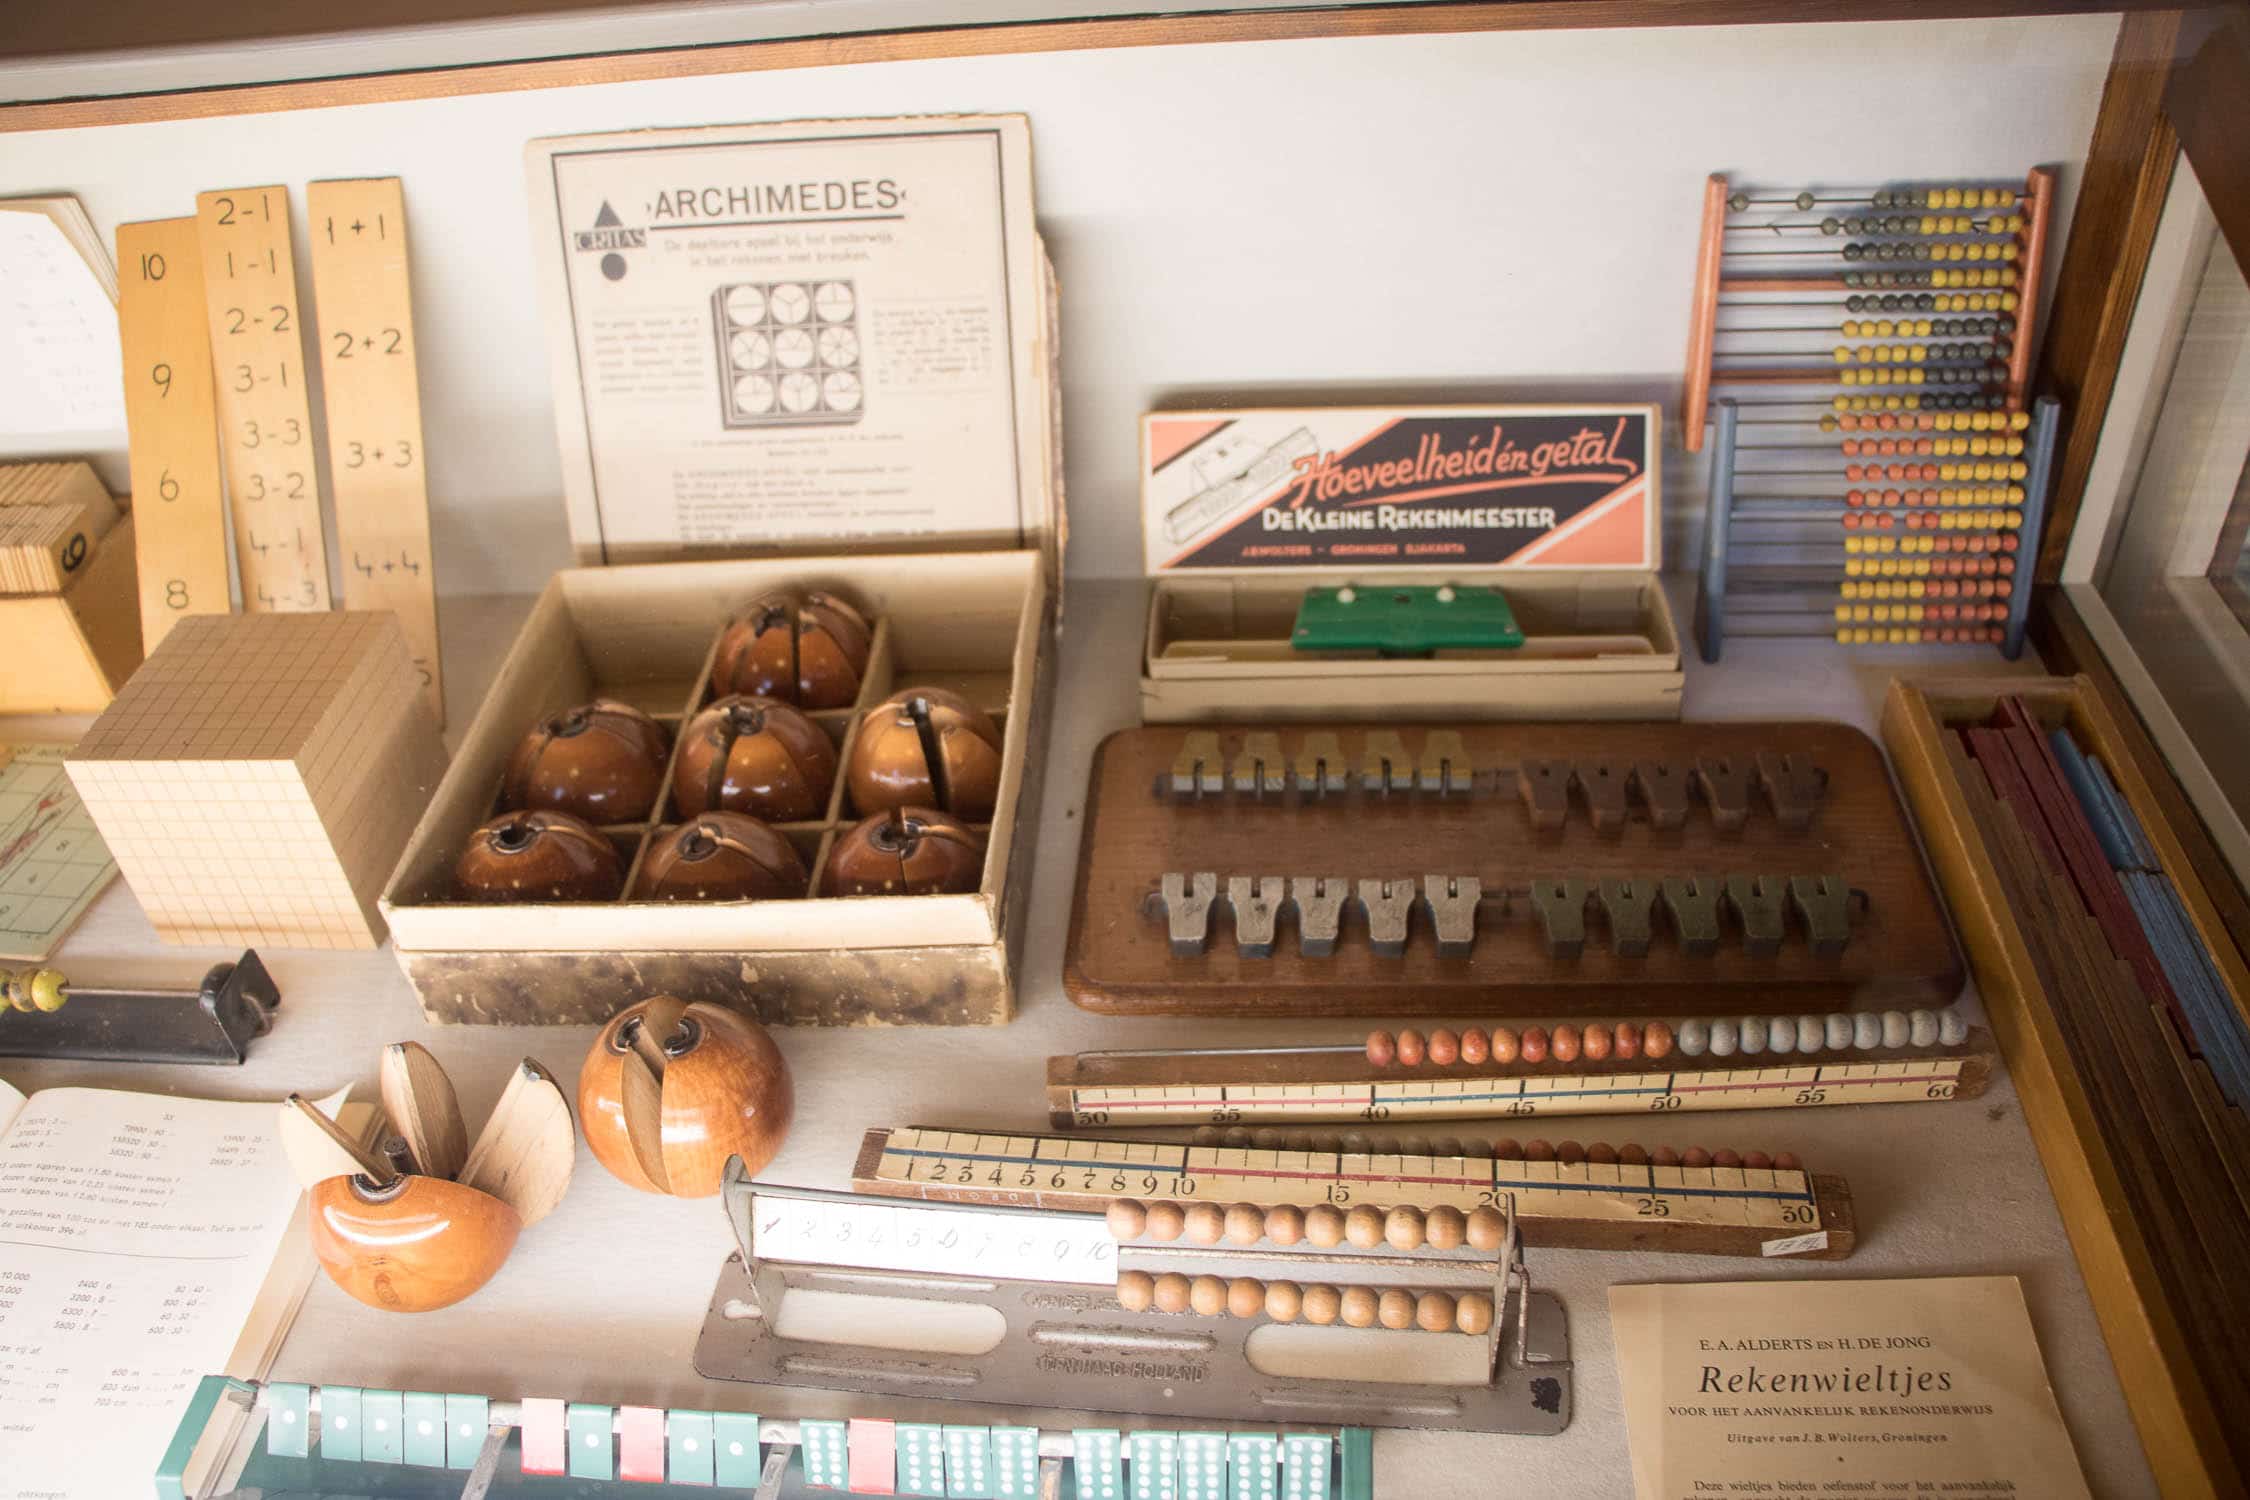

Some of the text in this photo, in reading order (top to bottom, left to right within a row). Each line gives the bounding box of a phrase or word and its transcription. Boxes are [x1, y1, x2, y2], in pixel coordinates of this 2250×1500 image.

[141, 253, 166, 281] 10
[152, 363, 173, 398] 9
[1290, 424, 1501, 510] Hoeveelheid
[1529, 416, 1639, 477] getal
[159, 469, 180, 502] 6
[1294, 506, 1375, 532] KLEINE
[1377, 505, 1556, 532] REKENMEESTER
[166, 580, 190, 609] 8
[1079, 1082, 1957, 1126] 30 35 40 45 50 55 60
[904, 1162, 1815, 1224] 1 2 3 4 5 6 7 8 9 10 15 20 25 30
[836, 1221, 851, 1242] 3
[1699, 1336, 1931, 1352] E. A. ALDERTS EN H. DE JONG
[1697, 1364, 1953, 1398] Rekenwieltjes
[1668, 1404, 1994, 1417] VOOR HET AANVANKELIJK REKENONDERWIJS
[1727, 1432, 1948, 1445] Uitgave van J. B. Wolters, Groningen
[1694, 1479, 2017, 1494] Deze wieltjes bieden oefenstof voor het aanvankelijk
